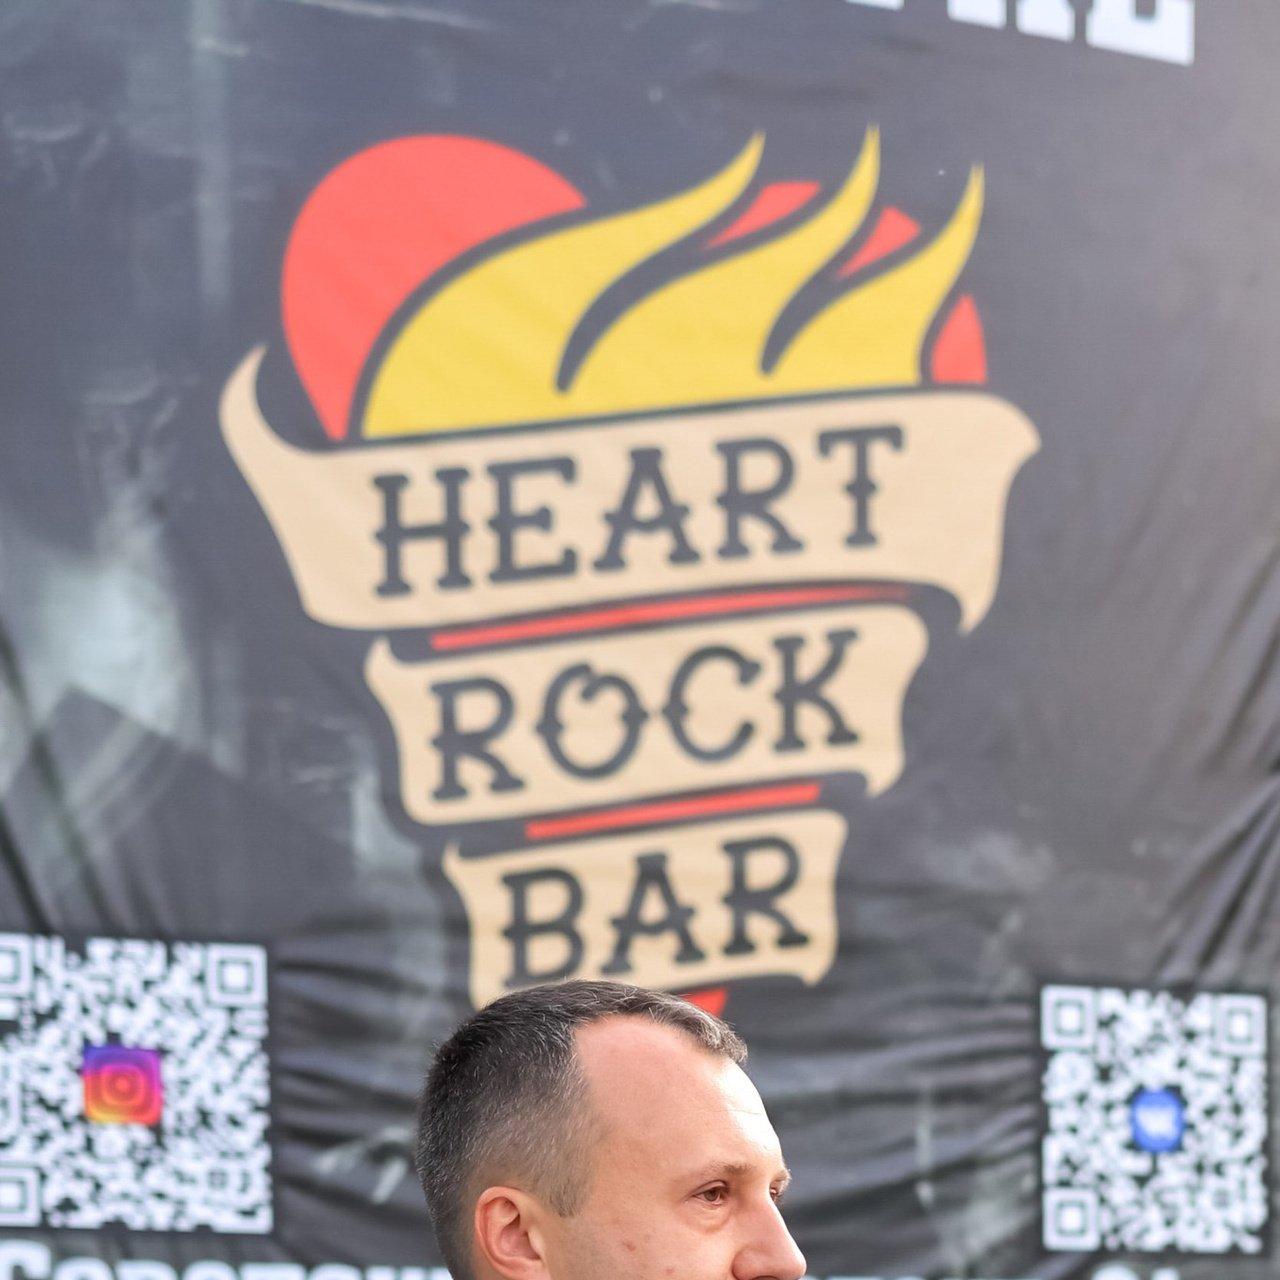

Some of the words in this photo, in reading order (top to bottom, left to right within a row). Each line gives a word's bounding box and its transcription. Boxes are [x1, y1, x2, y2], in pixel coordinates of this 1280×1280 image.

[372, 423, 905, 600] HEART
[428, 626, 860, 803] ROCK
[498, 835, 810, 988] BAR
